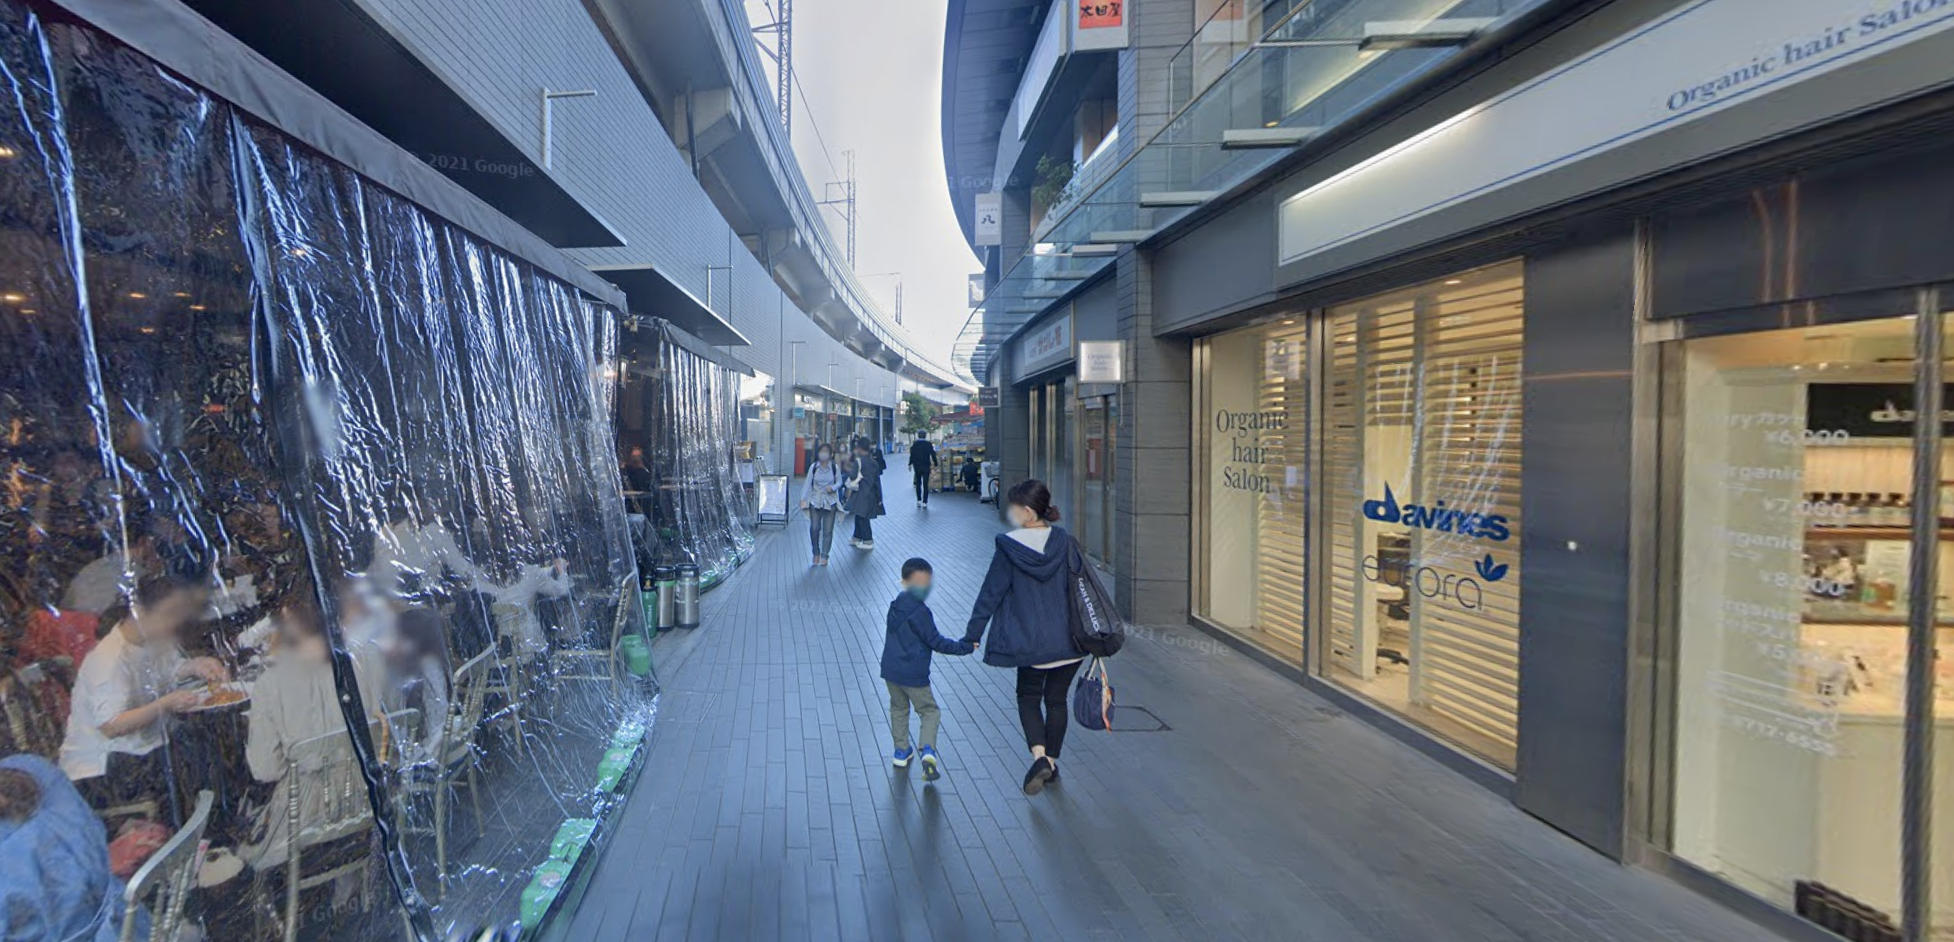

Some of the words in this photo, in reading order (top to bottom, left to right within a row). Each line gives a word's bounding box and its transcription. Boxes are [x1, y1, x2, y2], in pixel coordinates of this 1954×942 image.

[1667, 58, 1777, 111] Organic
[1783, 27, 1851, 65] hair
[1859, 0, 1949, 37] Salo
[1216, 409, 1289, 438] Organic
[1232, 437, 1269, 464] hair
[1224, 466, 1270, 493] Salon
[1362, 480, 1510, 541] davines
